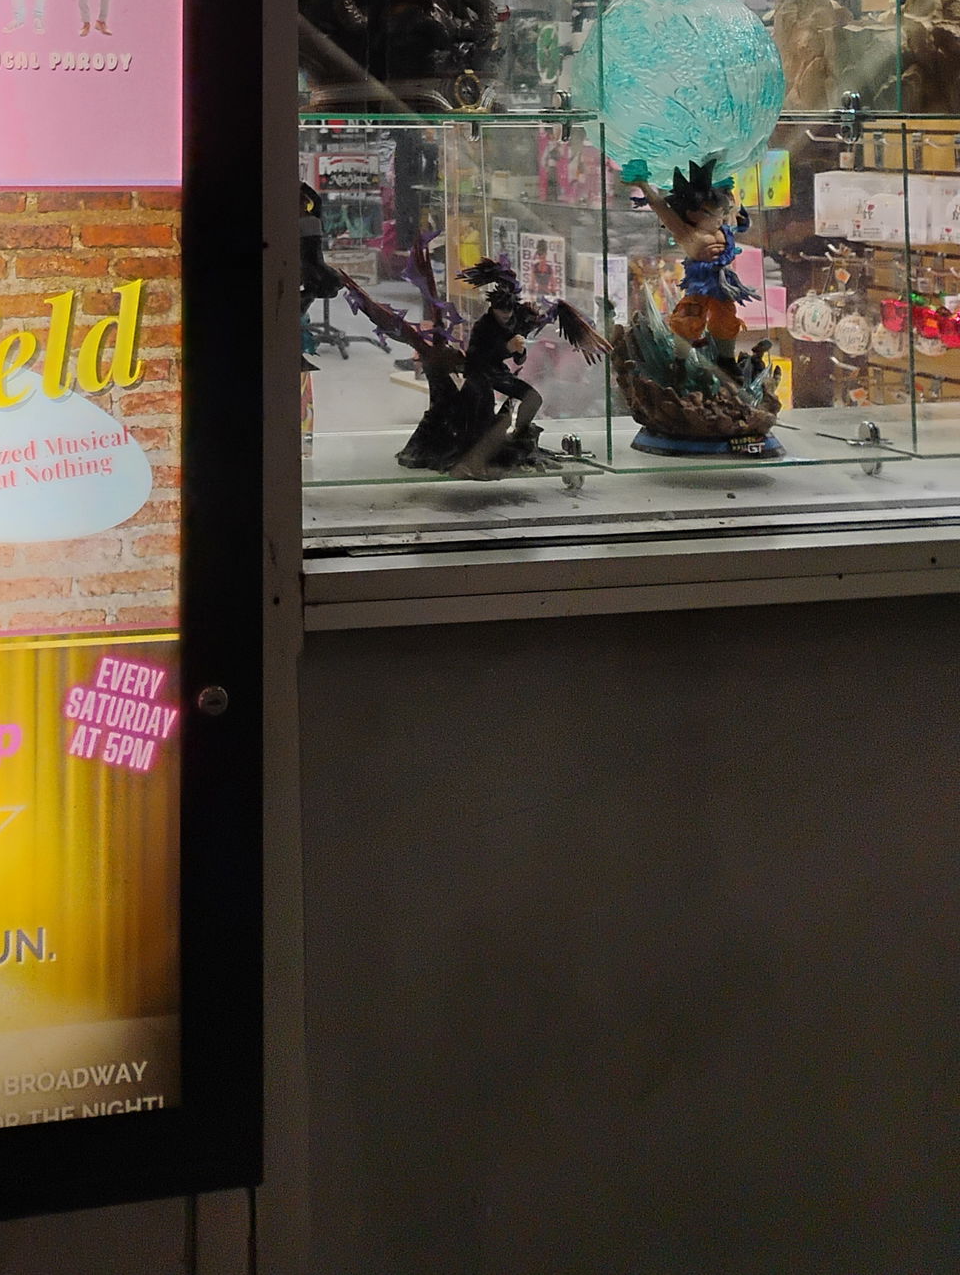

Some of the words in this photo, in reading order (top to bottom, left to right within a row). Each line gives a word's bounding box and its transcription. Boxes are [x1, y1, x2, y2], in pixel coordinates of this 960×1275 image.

[49, 52, 133, 72] PARODY
[44, 424, 132, 457] Musical
[24, 455, 113, 487] Nothing
[96, 657, 165, 700] EVERY
[66, 687, 178, 739] SATURDAY
[69, 724, 102, 758] AT
[103, 731, 155, 771] 5PM
